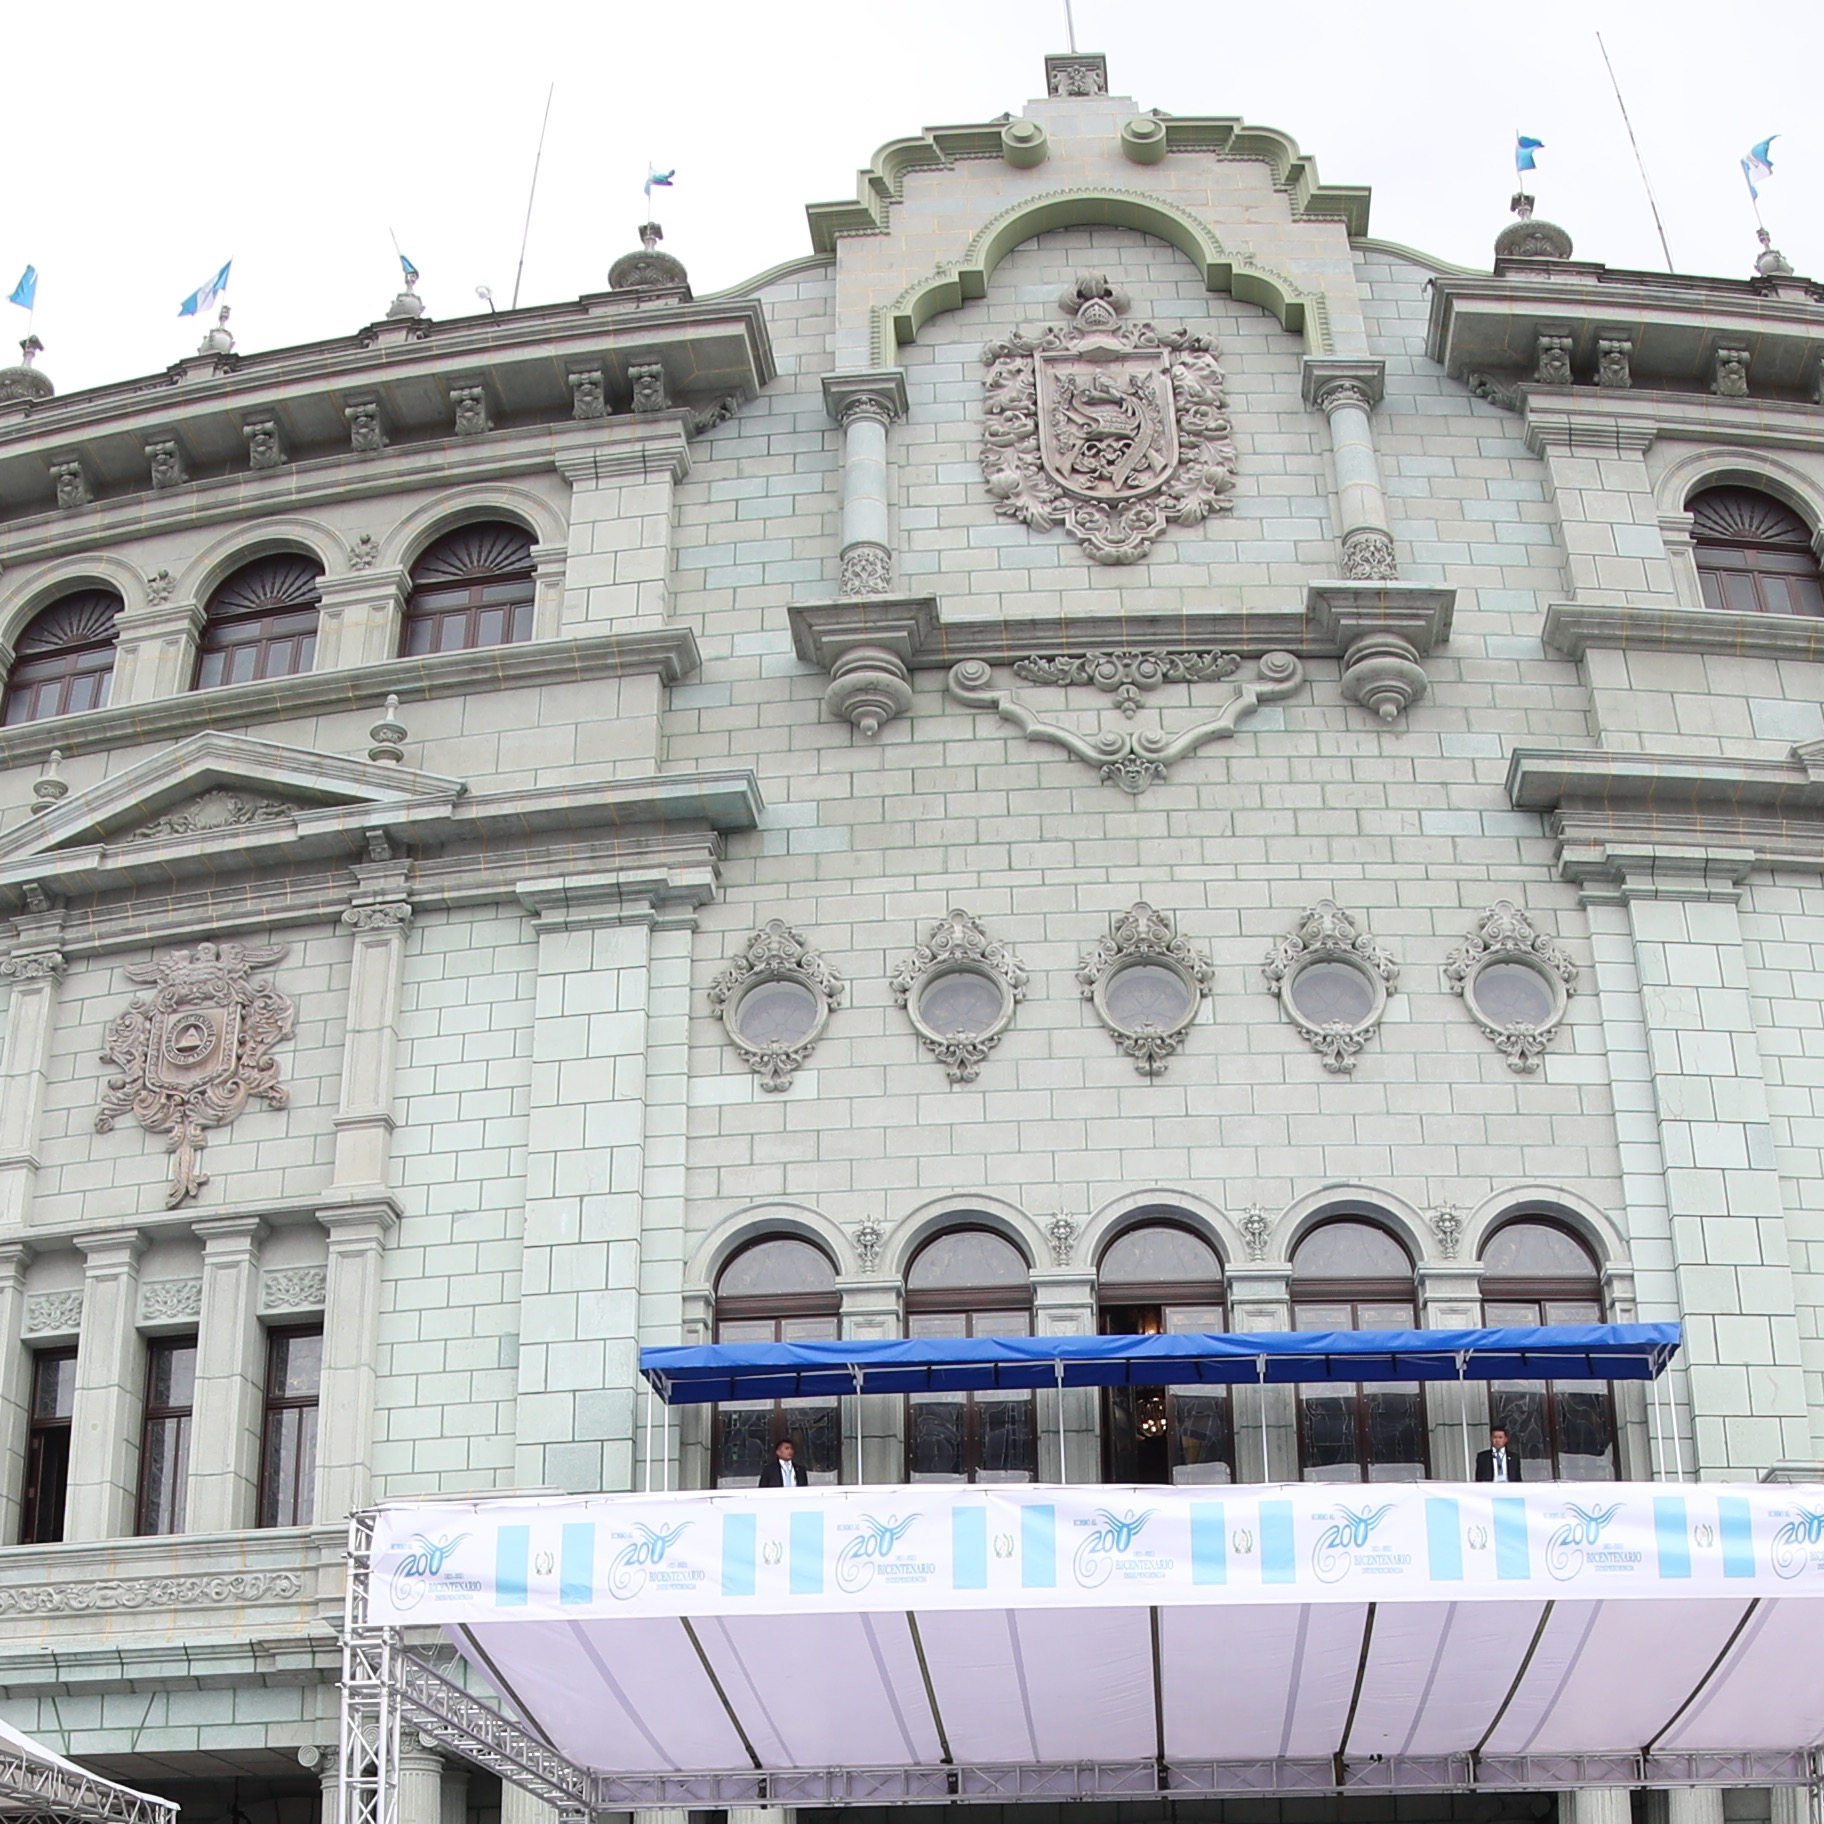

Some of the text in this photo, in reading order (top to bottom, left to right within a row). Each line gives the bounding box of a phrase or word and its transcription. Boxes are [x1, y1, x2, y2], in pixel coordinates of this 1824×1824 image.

[1354, 1555, 1411, 1566] BICENTENARIO
[1586, 1552, 1642, 1563] BICENTENARIO
[877, 1563, 936, 1575] BICENTENARIO
[1115, 1559, 1174, 1570] BICENTENARIO
[649, 1570, 706, 1582] BICENTENARIO
[429, 1581, 482, 1592] BICENTENARIO
